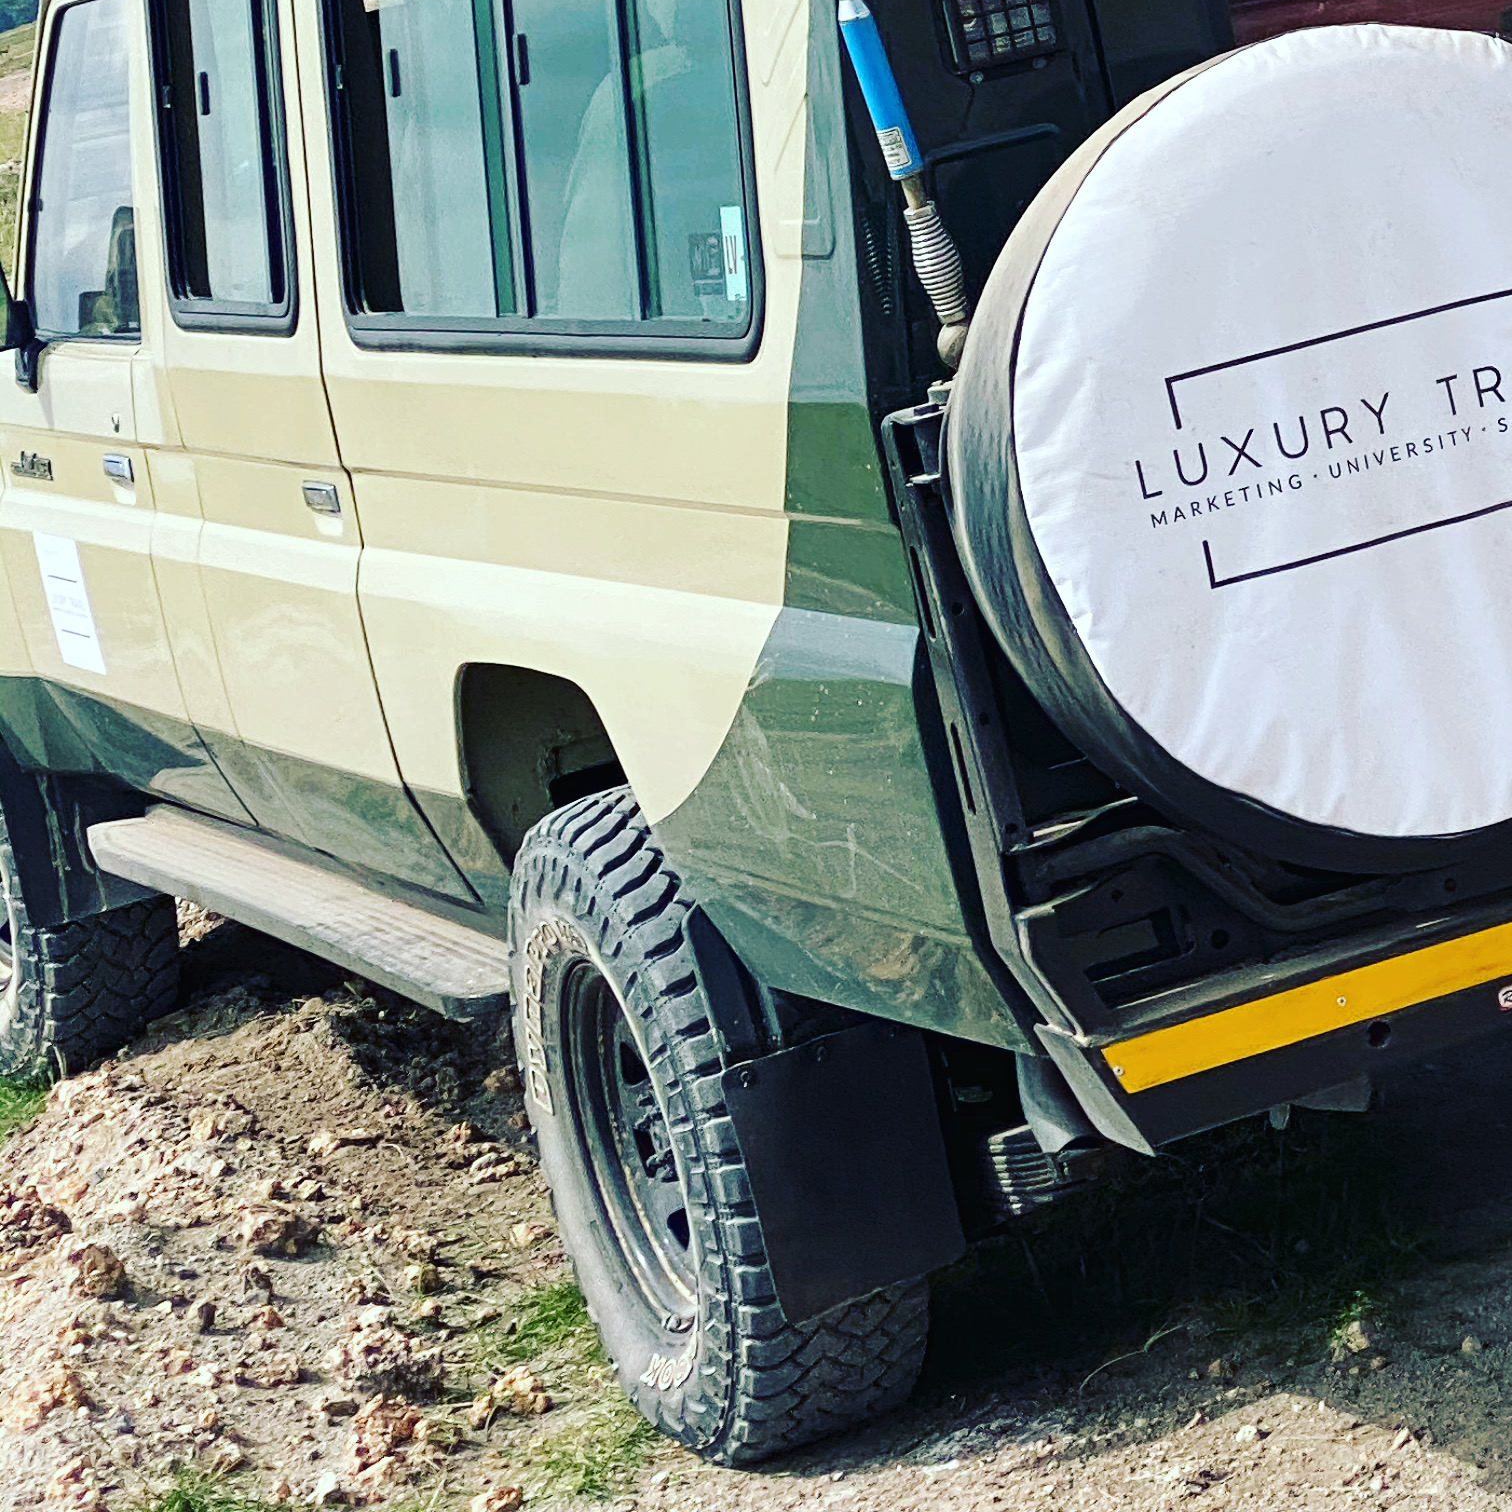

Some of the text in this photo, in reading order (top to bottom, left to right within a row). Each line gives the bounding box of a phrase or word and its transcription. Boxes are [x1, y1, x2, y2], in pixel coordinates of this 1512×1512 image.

[1134, 391, 1390, 500] LUXURY
[1150, 474, 1303, 529] MARKETING
[1328, 425, 1471, 479] UNIVERSITY
